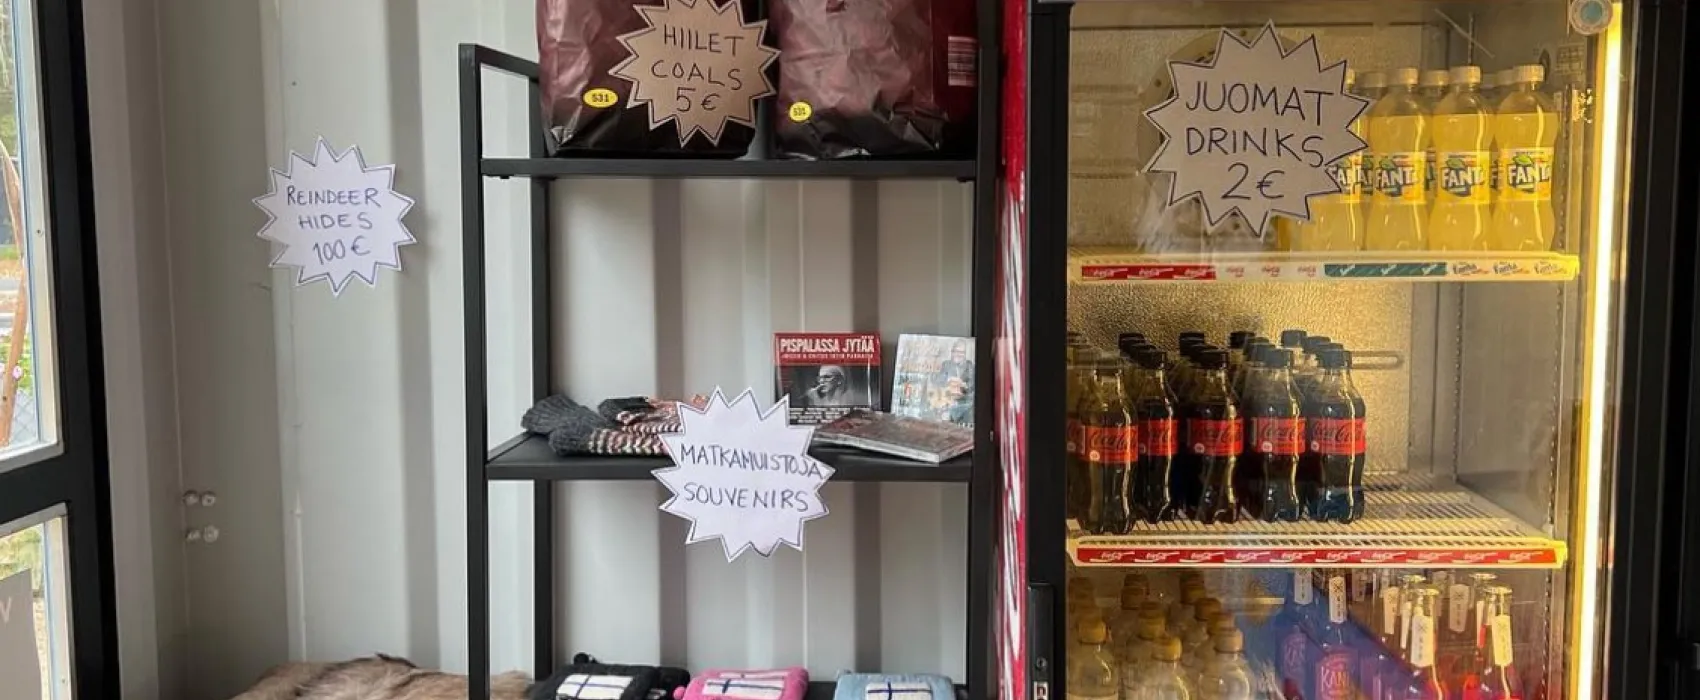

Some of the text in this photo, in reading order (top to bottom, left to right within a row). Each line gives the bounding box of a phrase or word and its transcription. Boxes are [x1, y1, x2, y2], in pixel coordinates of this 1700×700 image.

[664, 23, 744, 57] HIILET
[651, 59, 742, 91] COALS
[1185, 80, 1335, 127] JUOMAT
[1185, 127, 1324, 169] DRINKS
[1375, 166, 1417, 188] FANT
[1441, 166, 1483, 188] FANT
[286, 184, 381, 208] REINDEER
[298, 211, 373, 230] HIDES
[780, 335, 875, 353] PISPALASSA JYTÄÄ
[680, 443, 823, 479] MATKAMUISTOJA
[683, 481, 809, 513] SOUVENIRS
